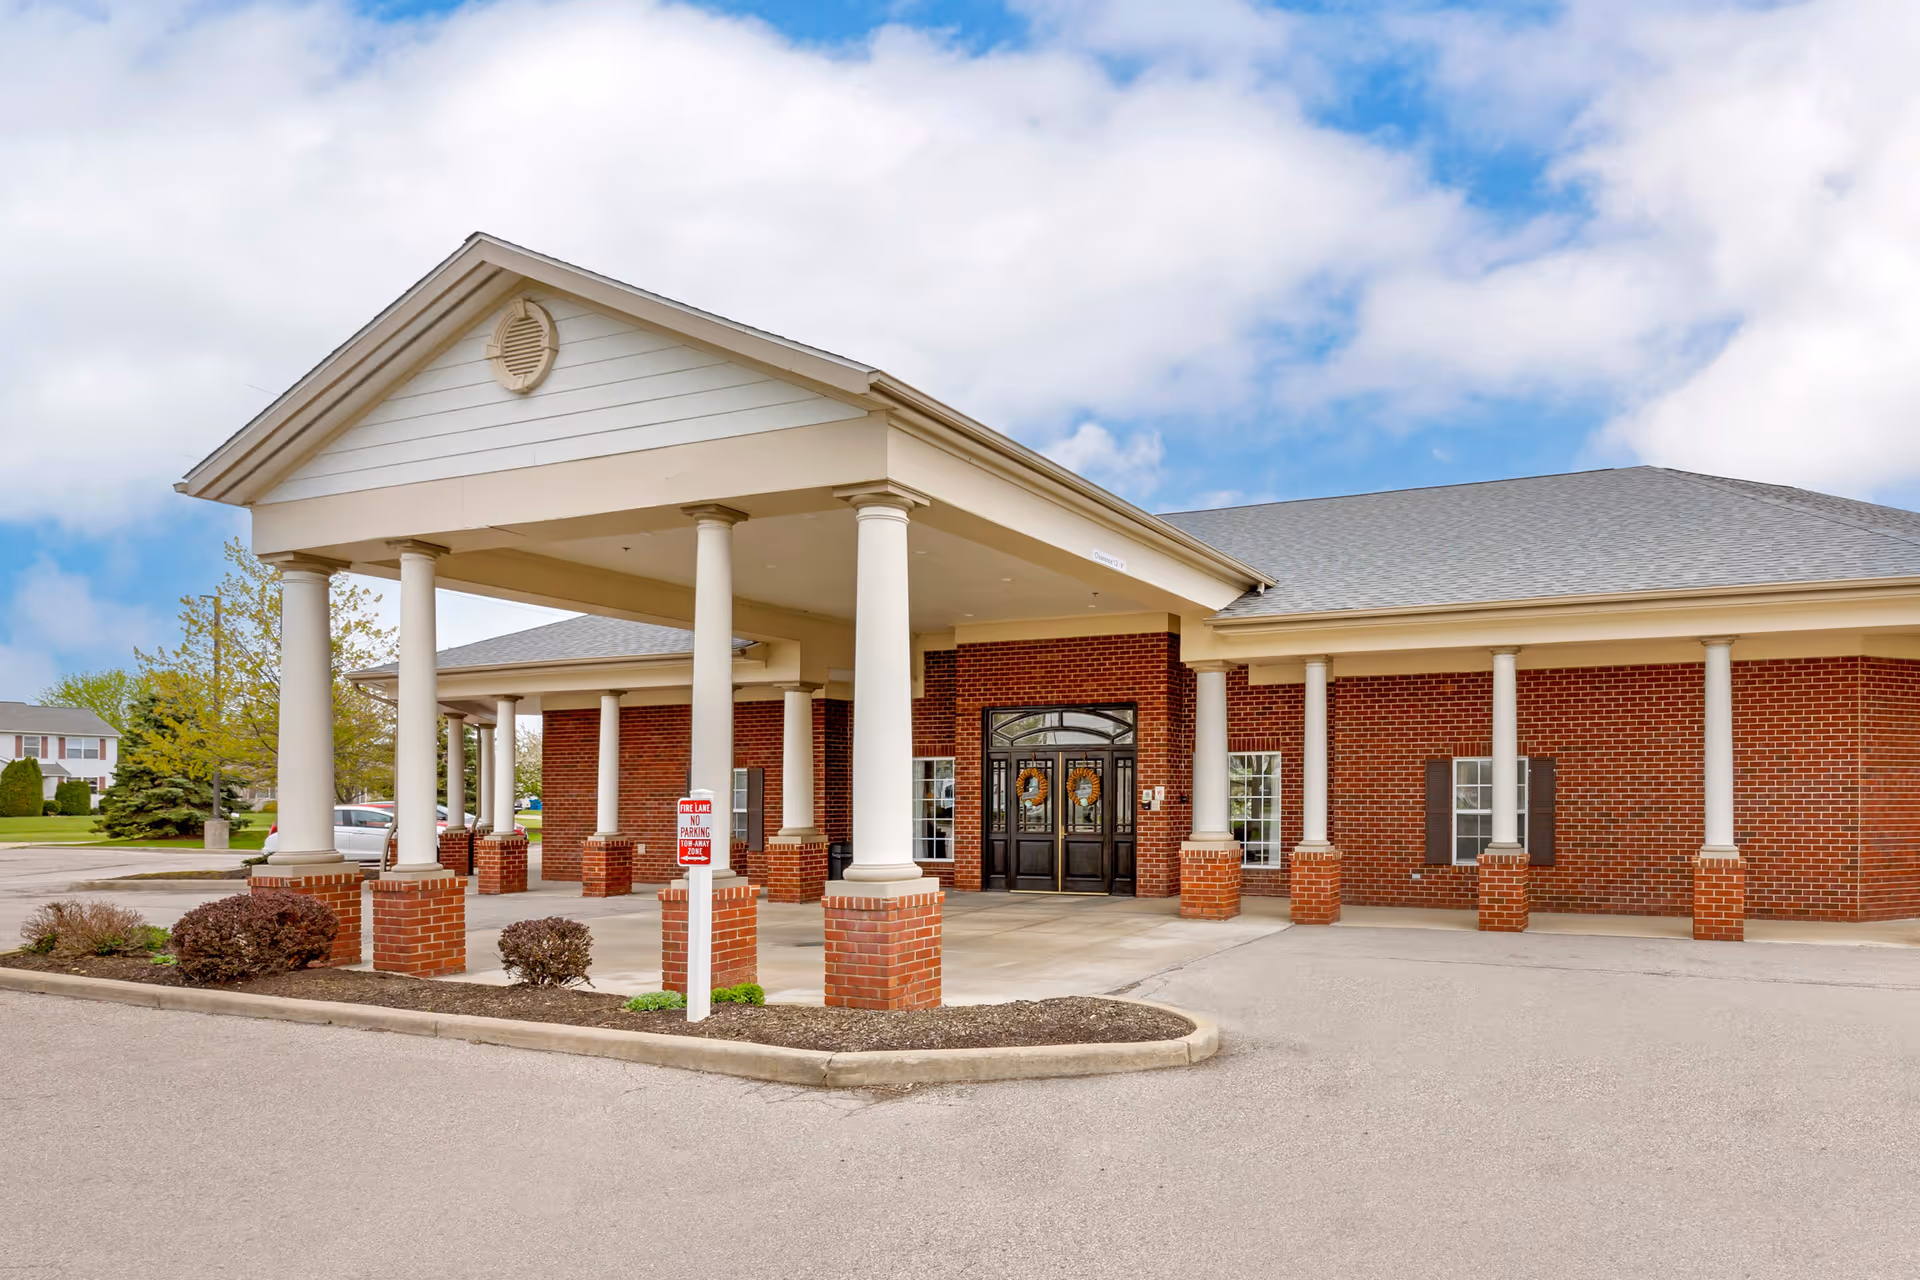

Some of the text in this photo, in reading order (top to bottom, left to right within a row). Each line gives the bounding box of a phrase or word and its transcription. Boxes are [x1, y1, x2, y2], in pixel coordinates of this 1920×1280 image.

[680, 804, 711, 813] FIRE LANE
[690, 815, 701, 826] NO
[680, 827, 710, 838] PARKING
